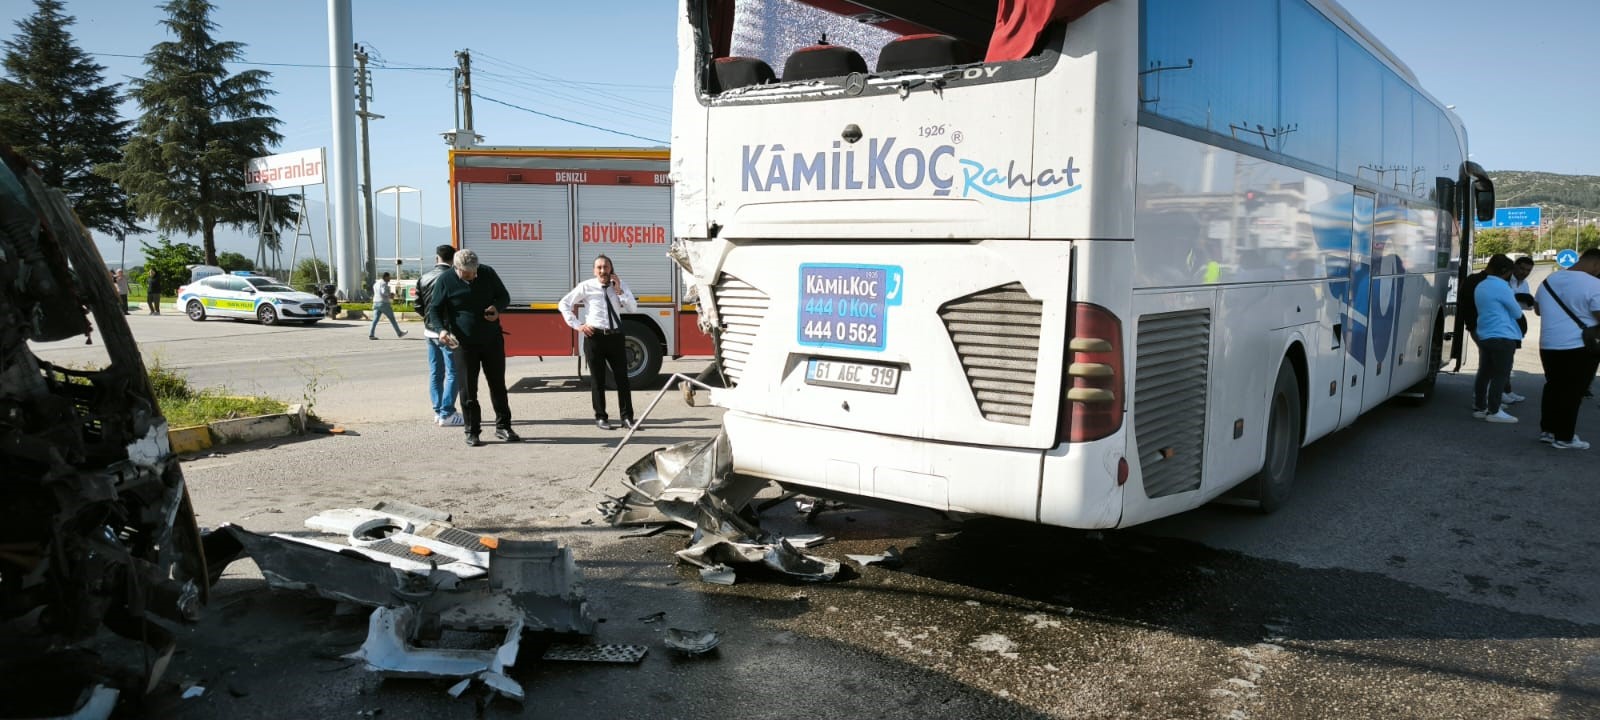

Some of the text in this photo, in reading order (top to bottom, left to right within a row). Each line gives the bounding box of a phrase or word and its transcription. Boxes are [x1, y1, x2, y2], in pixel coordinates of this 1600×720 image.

[919, 124, 945, 138] 1926
[959, 156, 1082, 202] Rahat
[491, 219, 665, 248] DENİZLİ BÜYÜKŞEHİR
[806, 298, 833, 315] 444
[805, 320, 877, 343] 444 0 562
[816, 363, 895, 386] 61 AGC 919
